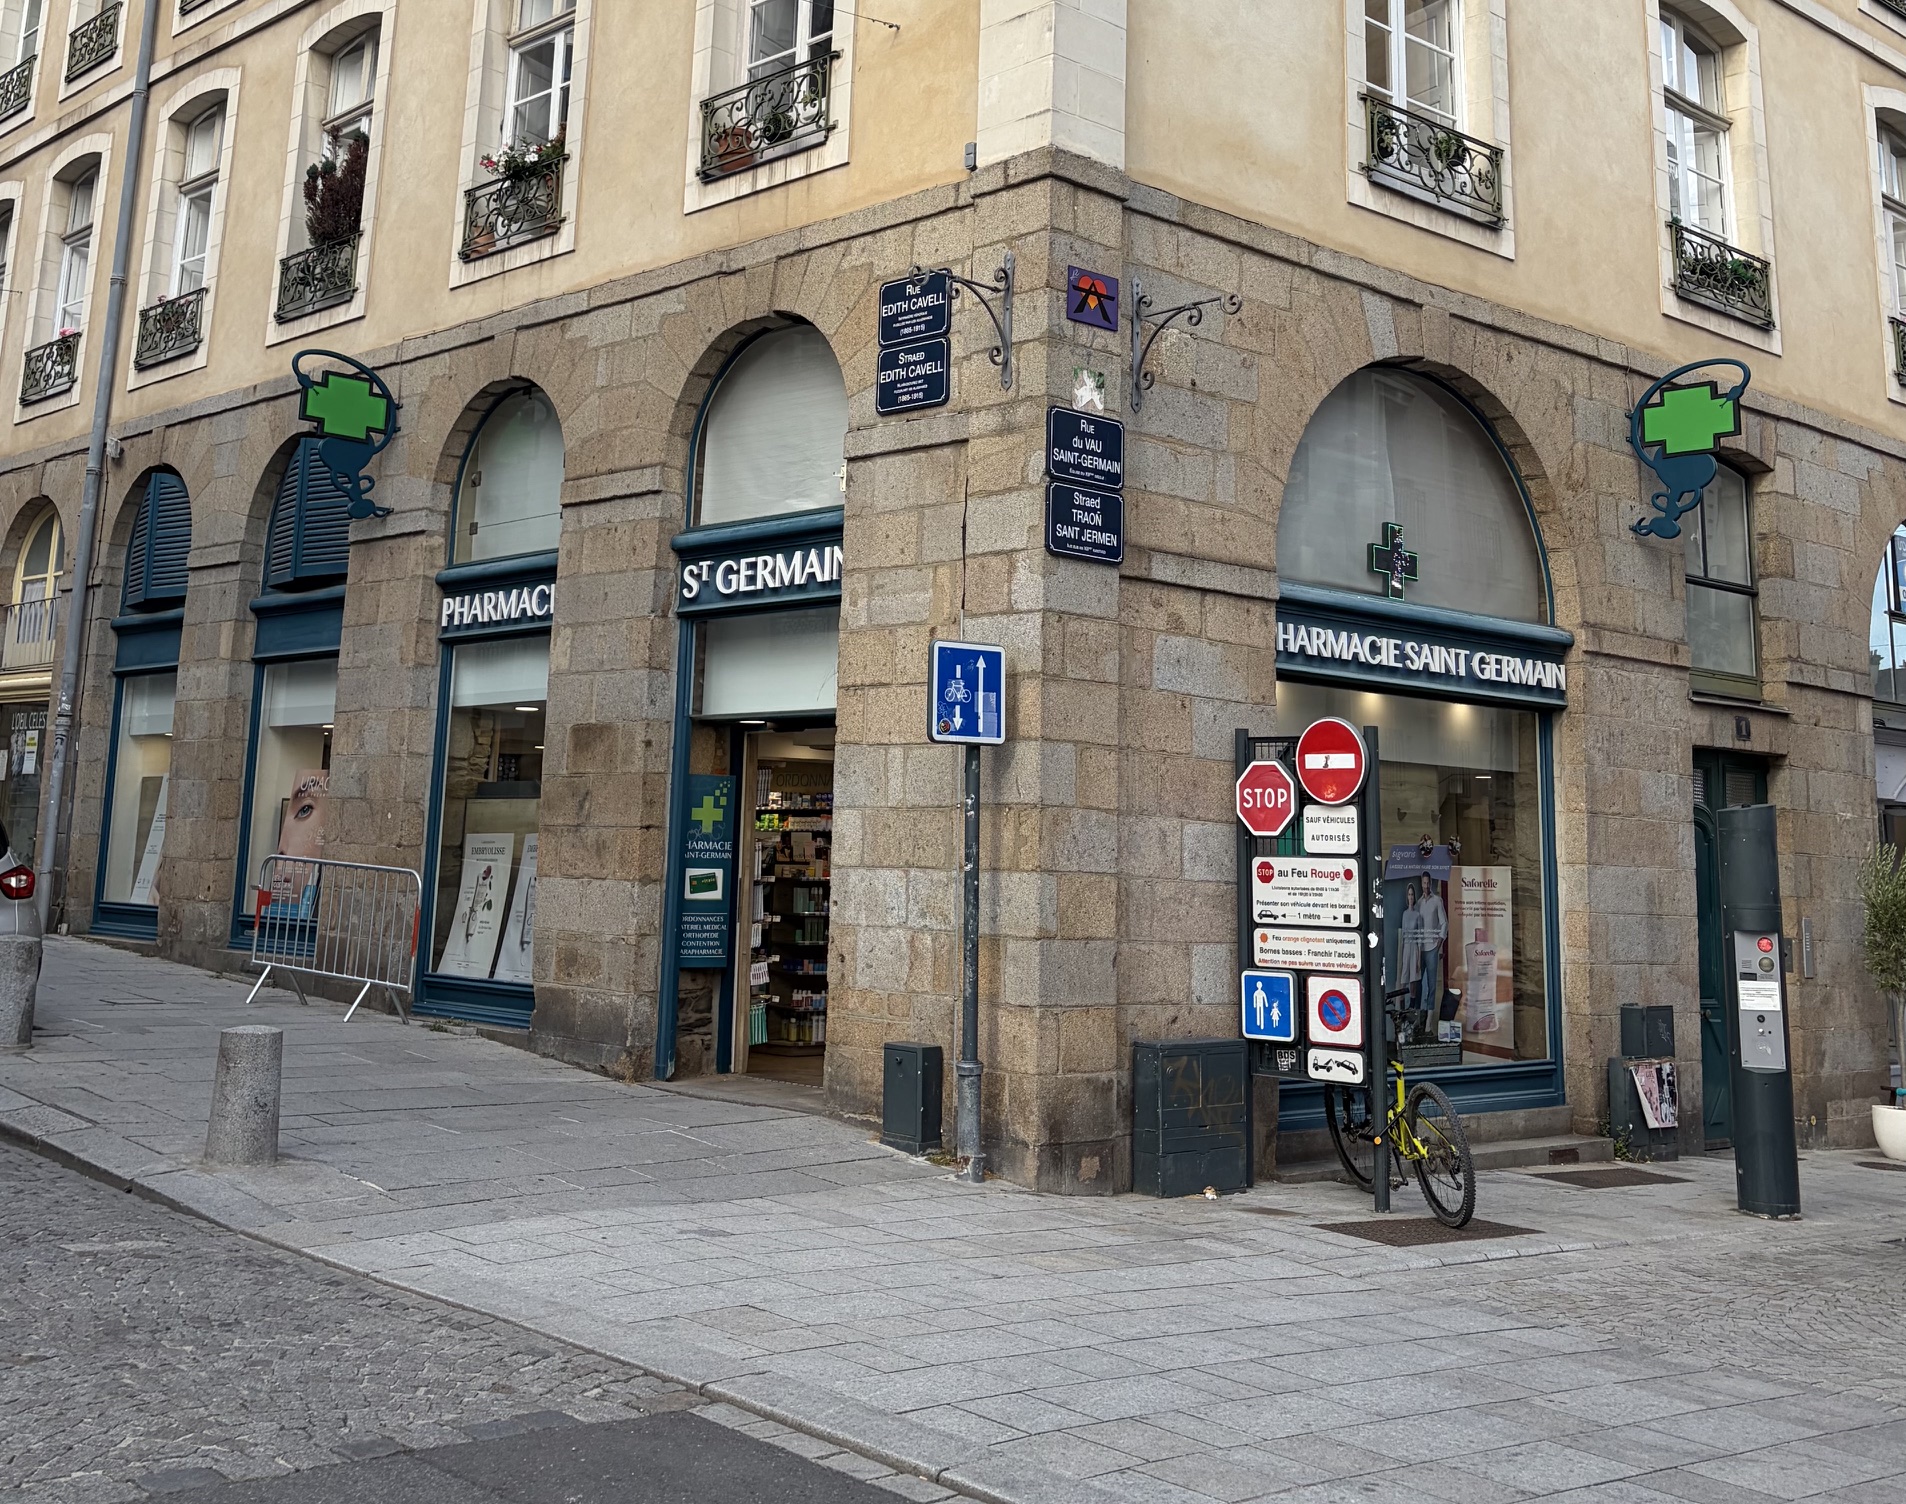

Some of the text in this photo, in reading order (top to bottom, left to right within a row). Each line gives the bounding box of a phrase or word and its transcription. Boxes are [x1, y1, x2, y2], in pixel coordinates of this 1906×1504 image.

[882, 300, 909, 317] EDITH
[910, 292, 946, 310] CAVELL
[880, 360, 944, 383] EDITH CAVELL
[1072, 435, 1102, 453] du VAU
[1053, 447, 1121, 475] SAINT-GERMAIN
[1073, 491, 1101, 509] Straed
[1071, 508, 1102, 527] TRAOÑ
[1055, 523, 1118, 547] SANT JERMEN
[1403, 641, 1471, 677] SAINT
[1470, 651, 1567, 691] GERMAIN
[1740, 720, 1747, 736] 1
[1243, 787, 1288, 808] STOP
[1305, 814, 1356, 824] SAUF VÉHICULES
[1310, 833, 1351, 842] AUTORISÉS
[1257, 867, 1341, 881] STOP au Feu Rouge
[1461, 877, 1498, 889] Saforelle
[1256, 899, 1280, 907] Présenter
[1290, 900, 1311, 908] véhicule
[1302, 912, 1321, 920] mètre
[1300, 936, 1325, 944] clignotant
[1325, 937, 1356, 945] uniquement
[1259, 946, 1280, 954] Bornes
[1281, 948, 1303, 956] basses
[1307, 949, 1333, 957] Franchir
[1258, 957, 1281, 965] Attention
